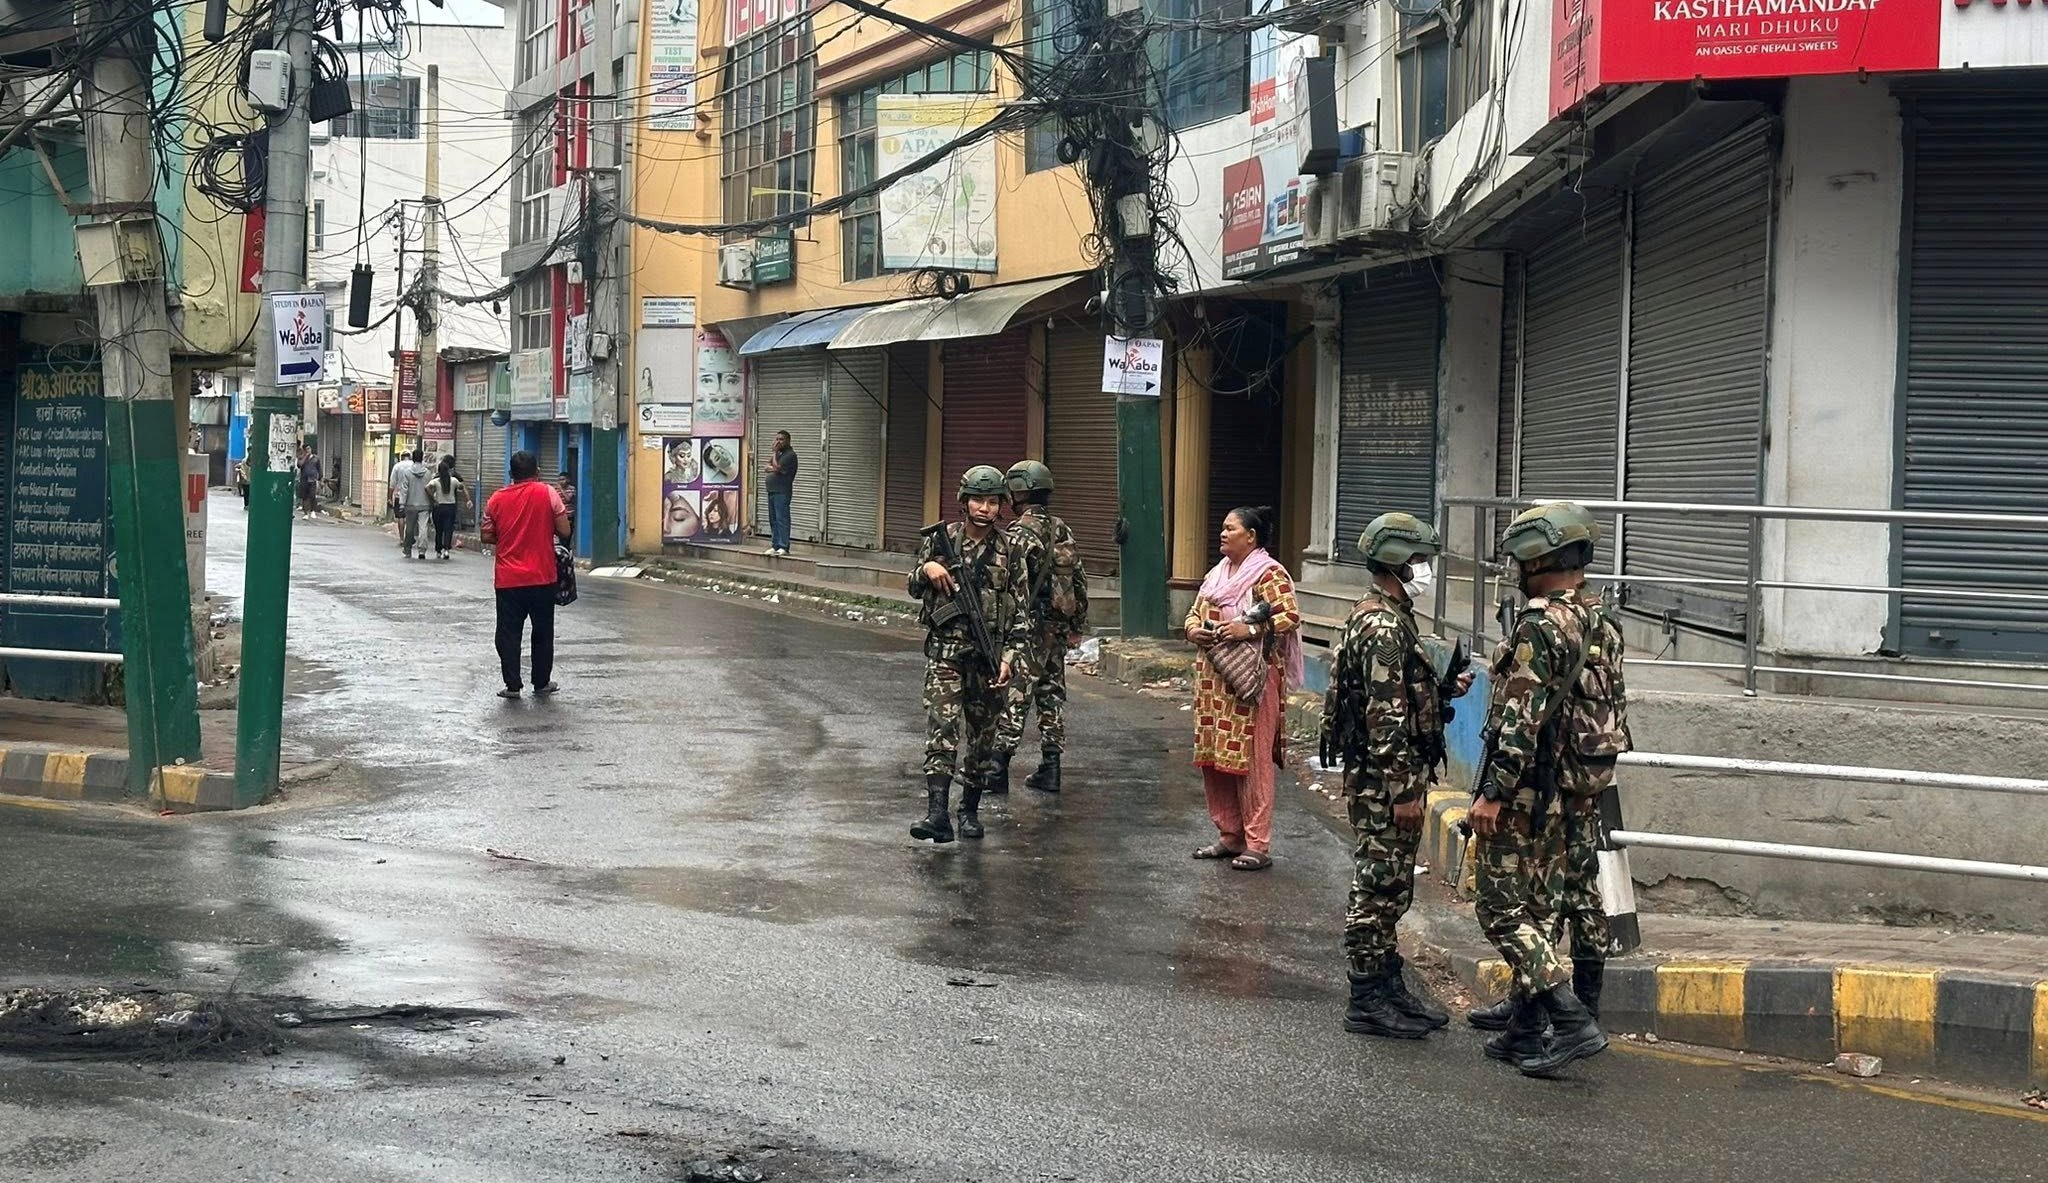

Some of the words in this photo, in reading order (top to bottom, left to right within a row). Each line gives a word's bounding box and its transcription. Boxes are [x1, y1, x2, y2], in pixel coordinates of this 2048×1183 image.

[728, 0, 796, 42] IEL
[1696, 22, 1749, 38] MARI
[1760, 17, 1840, 35] DHUKU
[664, 47, 682, 55] TEST
[1695, 47, 1711, 56] AN
[1712, 45, 1743, 55] OASIS
[1744, 44, 1758, 54] OF
[1760, 42, 1797, 54] NEPALI
[1798, 40, 1838, 52] SWEETS
[274, 300, 292, 309] STUDY
[292, 300, 299, 308] IN
